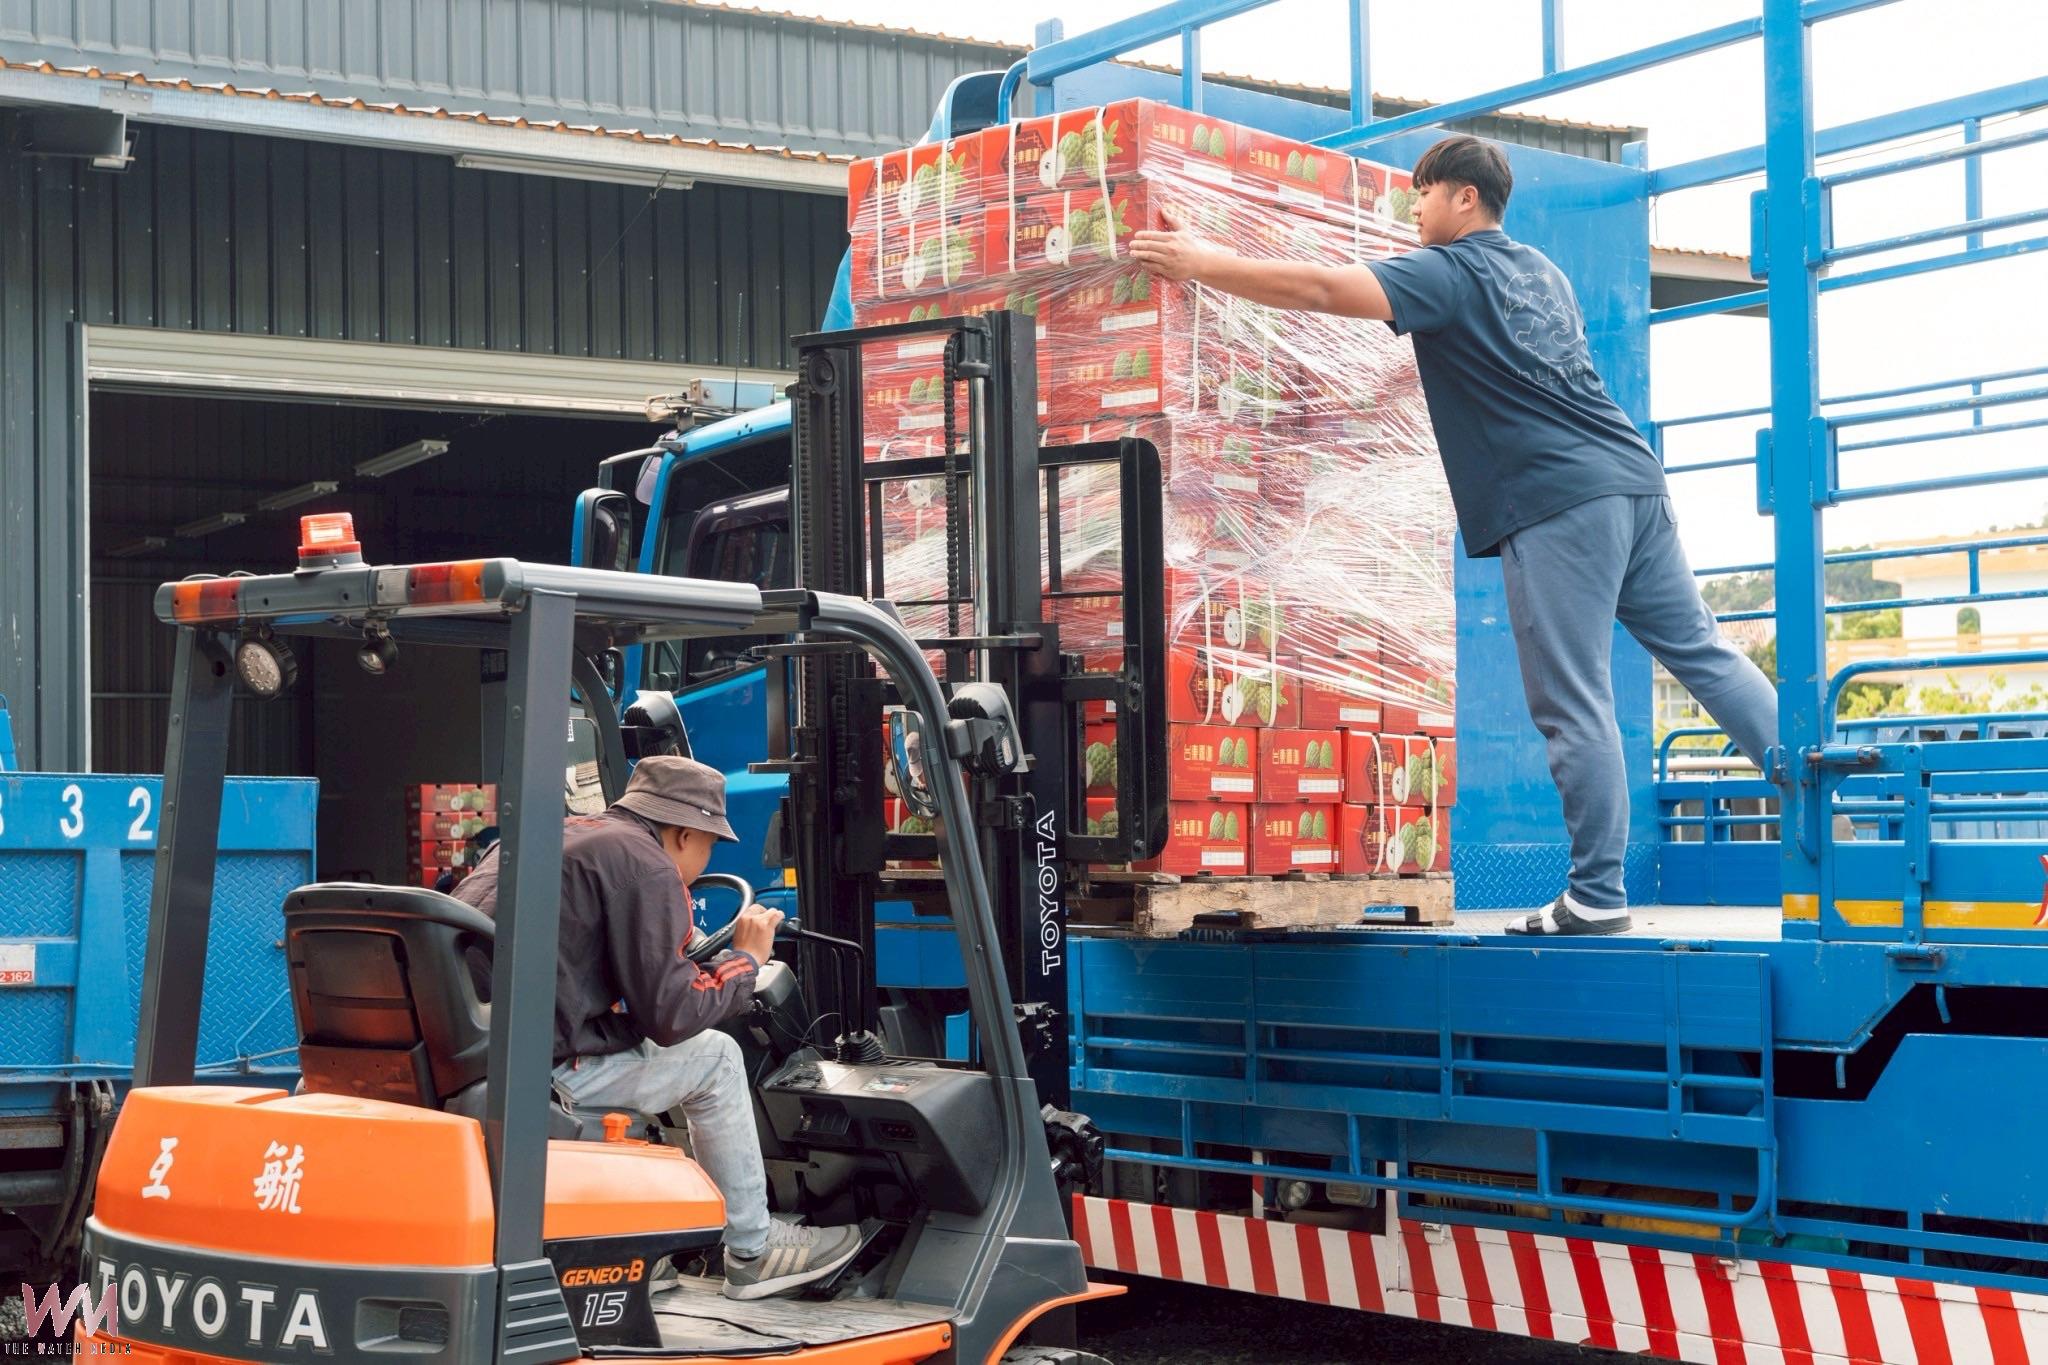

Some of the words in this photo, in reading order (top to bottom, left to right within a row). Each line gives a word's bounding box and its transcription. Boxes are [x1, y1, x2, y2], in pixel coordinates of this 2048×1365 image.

[1036, 810, 1061, 976] TOYOTA
[98, 1258, 331, 1350] TOYOTA
[582, 1291, 628, 1327] 15
